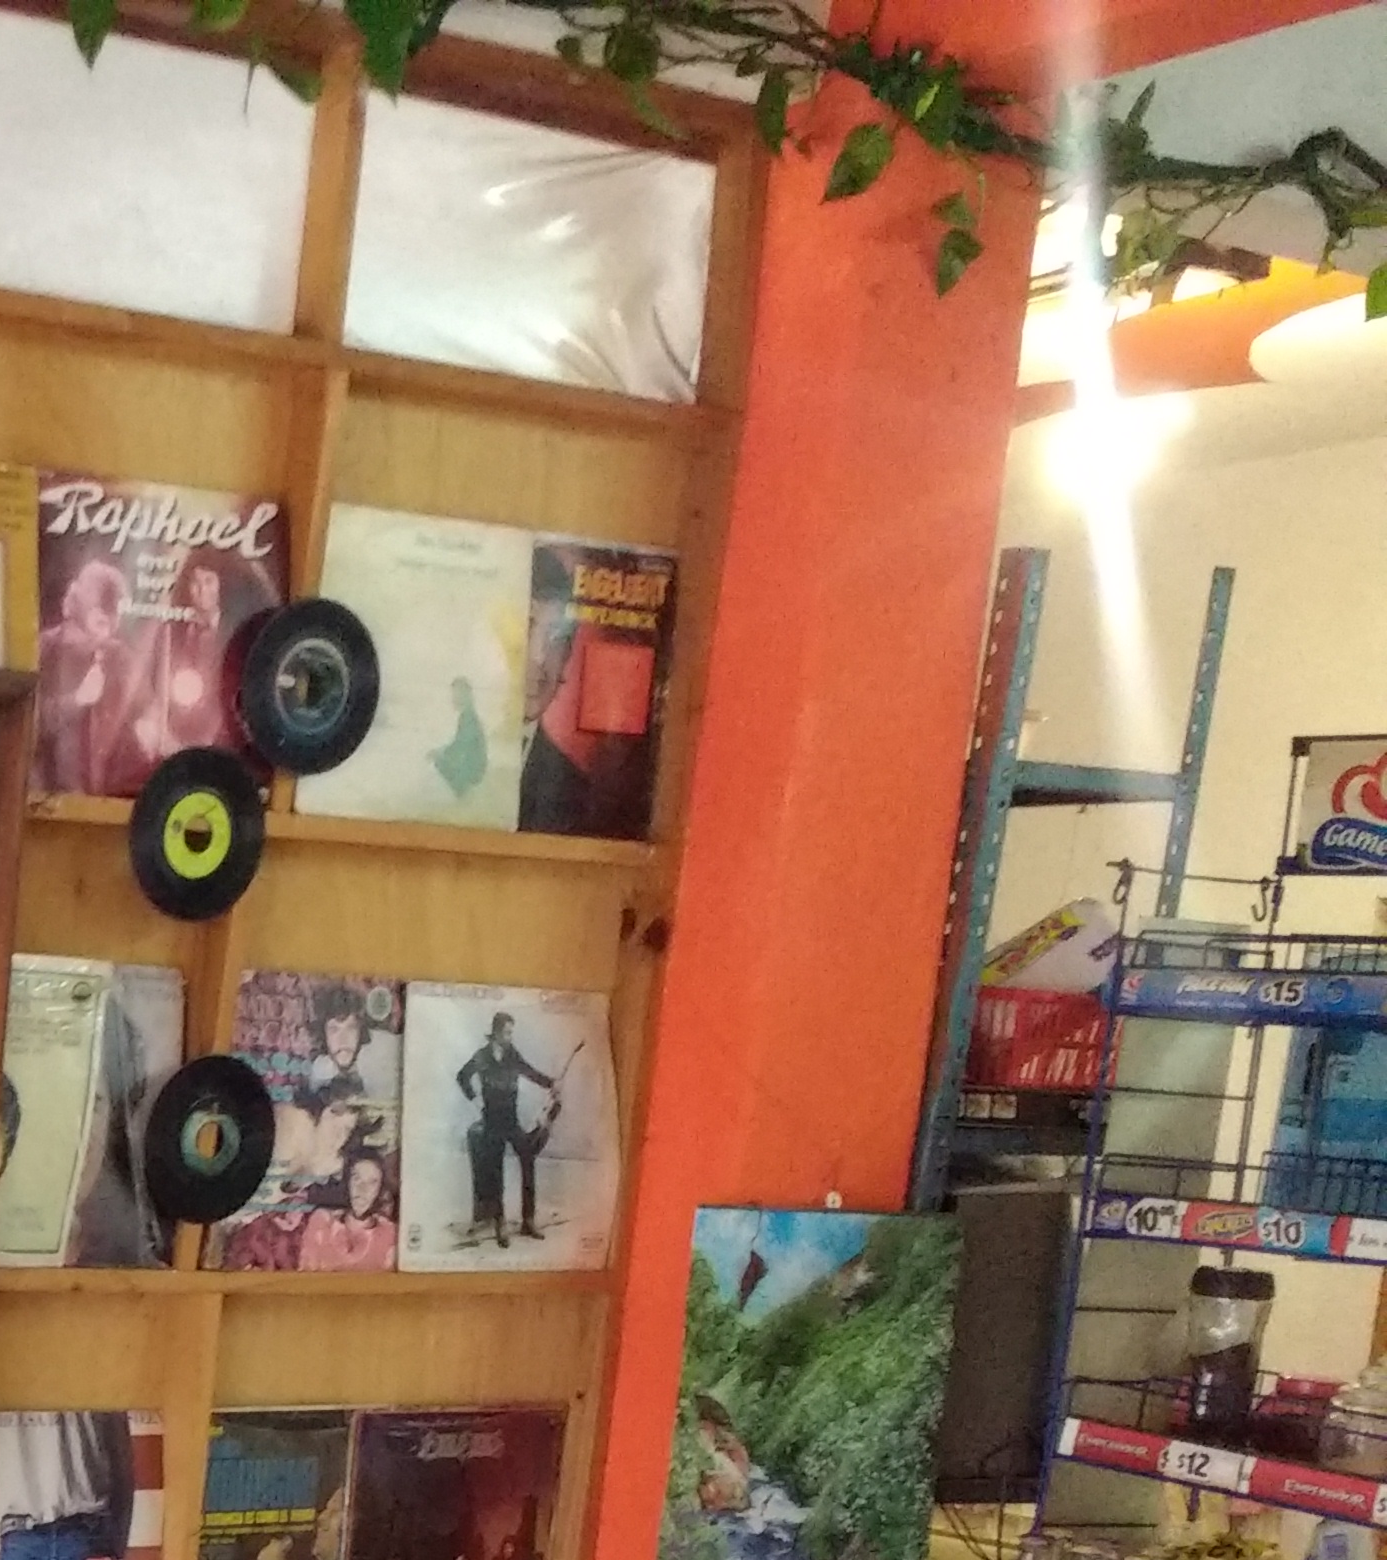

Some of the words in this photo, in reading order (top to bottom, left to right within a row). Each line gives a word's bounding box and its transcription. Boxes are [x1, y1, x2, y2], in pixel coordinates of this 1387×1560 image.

[40, 482, 279, 559] Raphael
[1323, 823, 1387, 857] Game
[1177, 1452, 1212, 1479] $12
